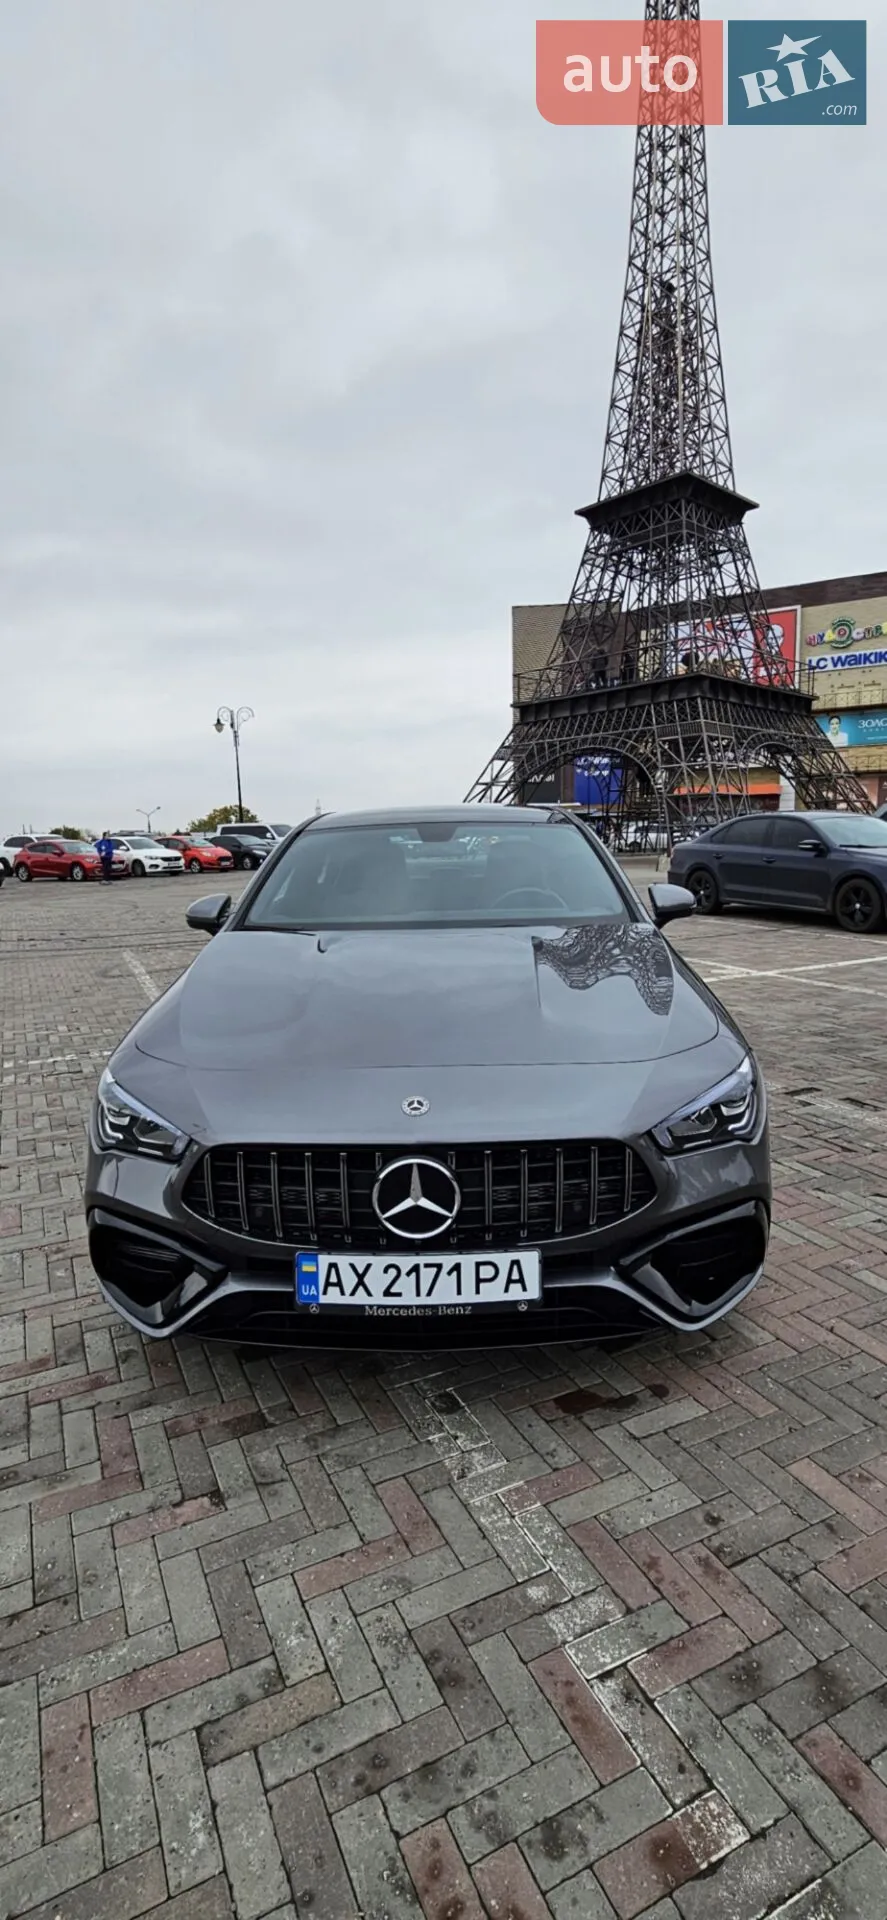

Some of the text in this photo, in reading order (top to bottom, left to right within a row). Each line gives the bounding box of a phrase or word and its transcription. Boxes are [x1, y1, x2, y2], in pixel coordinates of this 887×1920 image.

[322, 1259, 528, 1297] AX 2171 PA
[302, 1284, 317, 1296] UA
[364, 1305, 472, 1316] Mercedes-Benz
